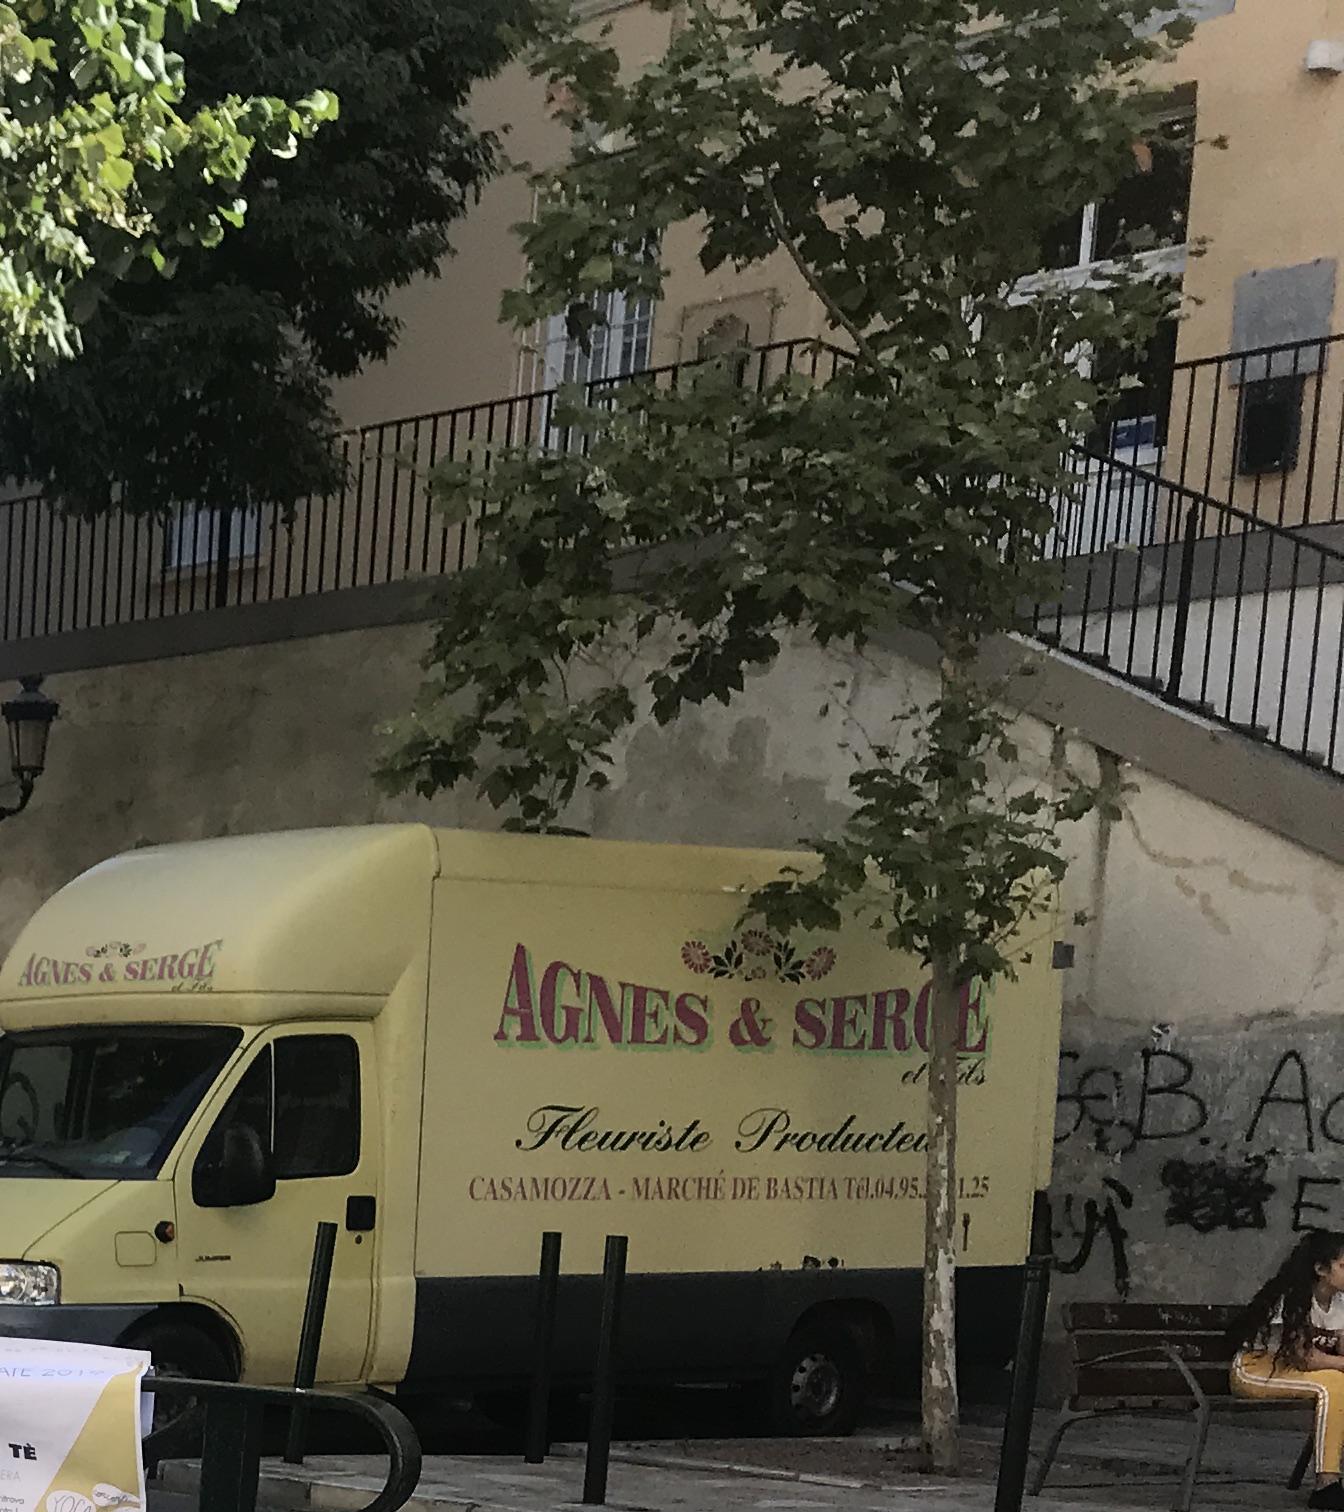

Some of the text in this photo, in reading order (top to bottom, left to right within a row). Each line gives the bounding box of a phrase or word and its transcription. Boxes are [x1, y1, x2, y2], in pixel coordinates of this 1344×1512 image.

[18, 938, 224, 988] AGNES & SERGE
[493, 942, 774, 1048] AGNES &
[514, 1103, 713, 1155] Fleuriste
[468, 1167, 840, 1202] CASAMOZZA MARCHÉ DE BASTIA
[8, 1442, 38, 1462] TÈ
